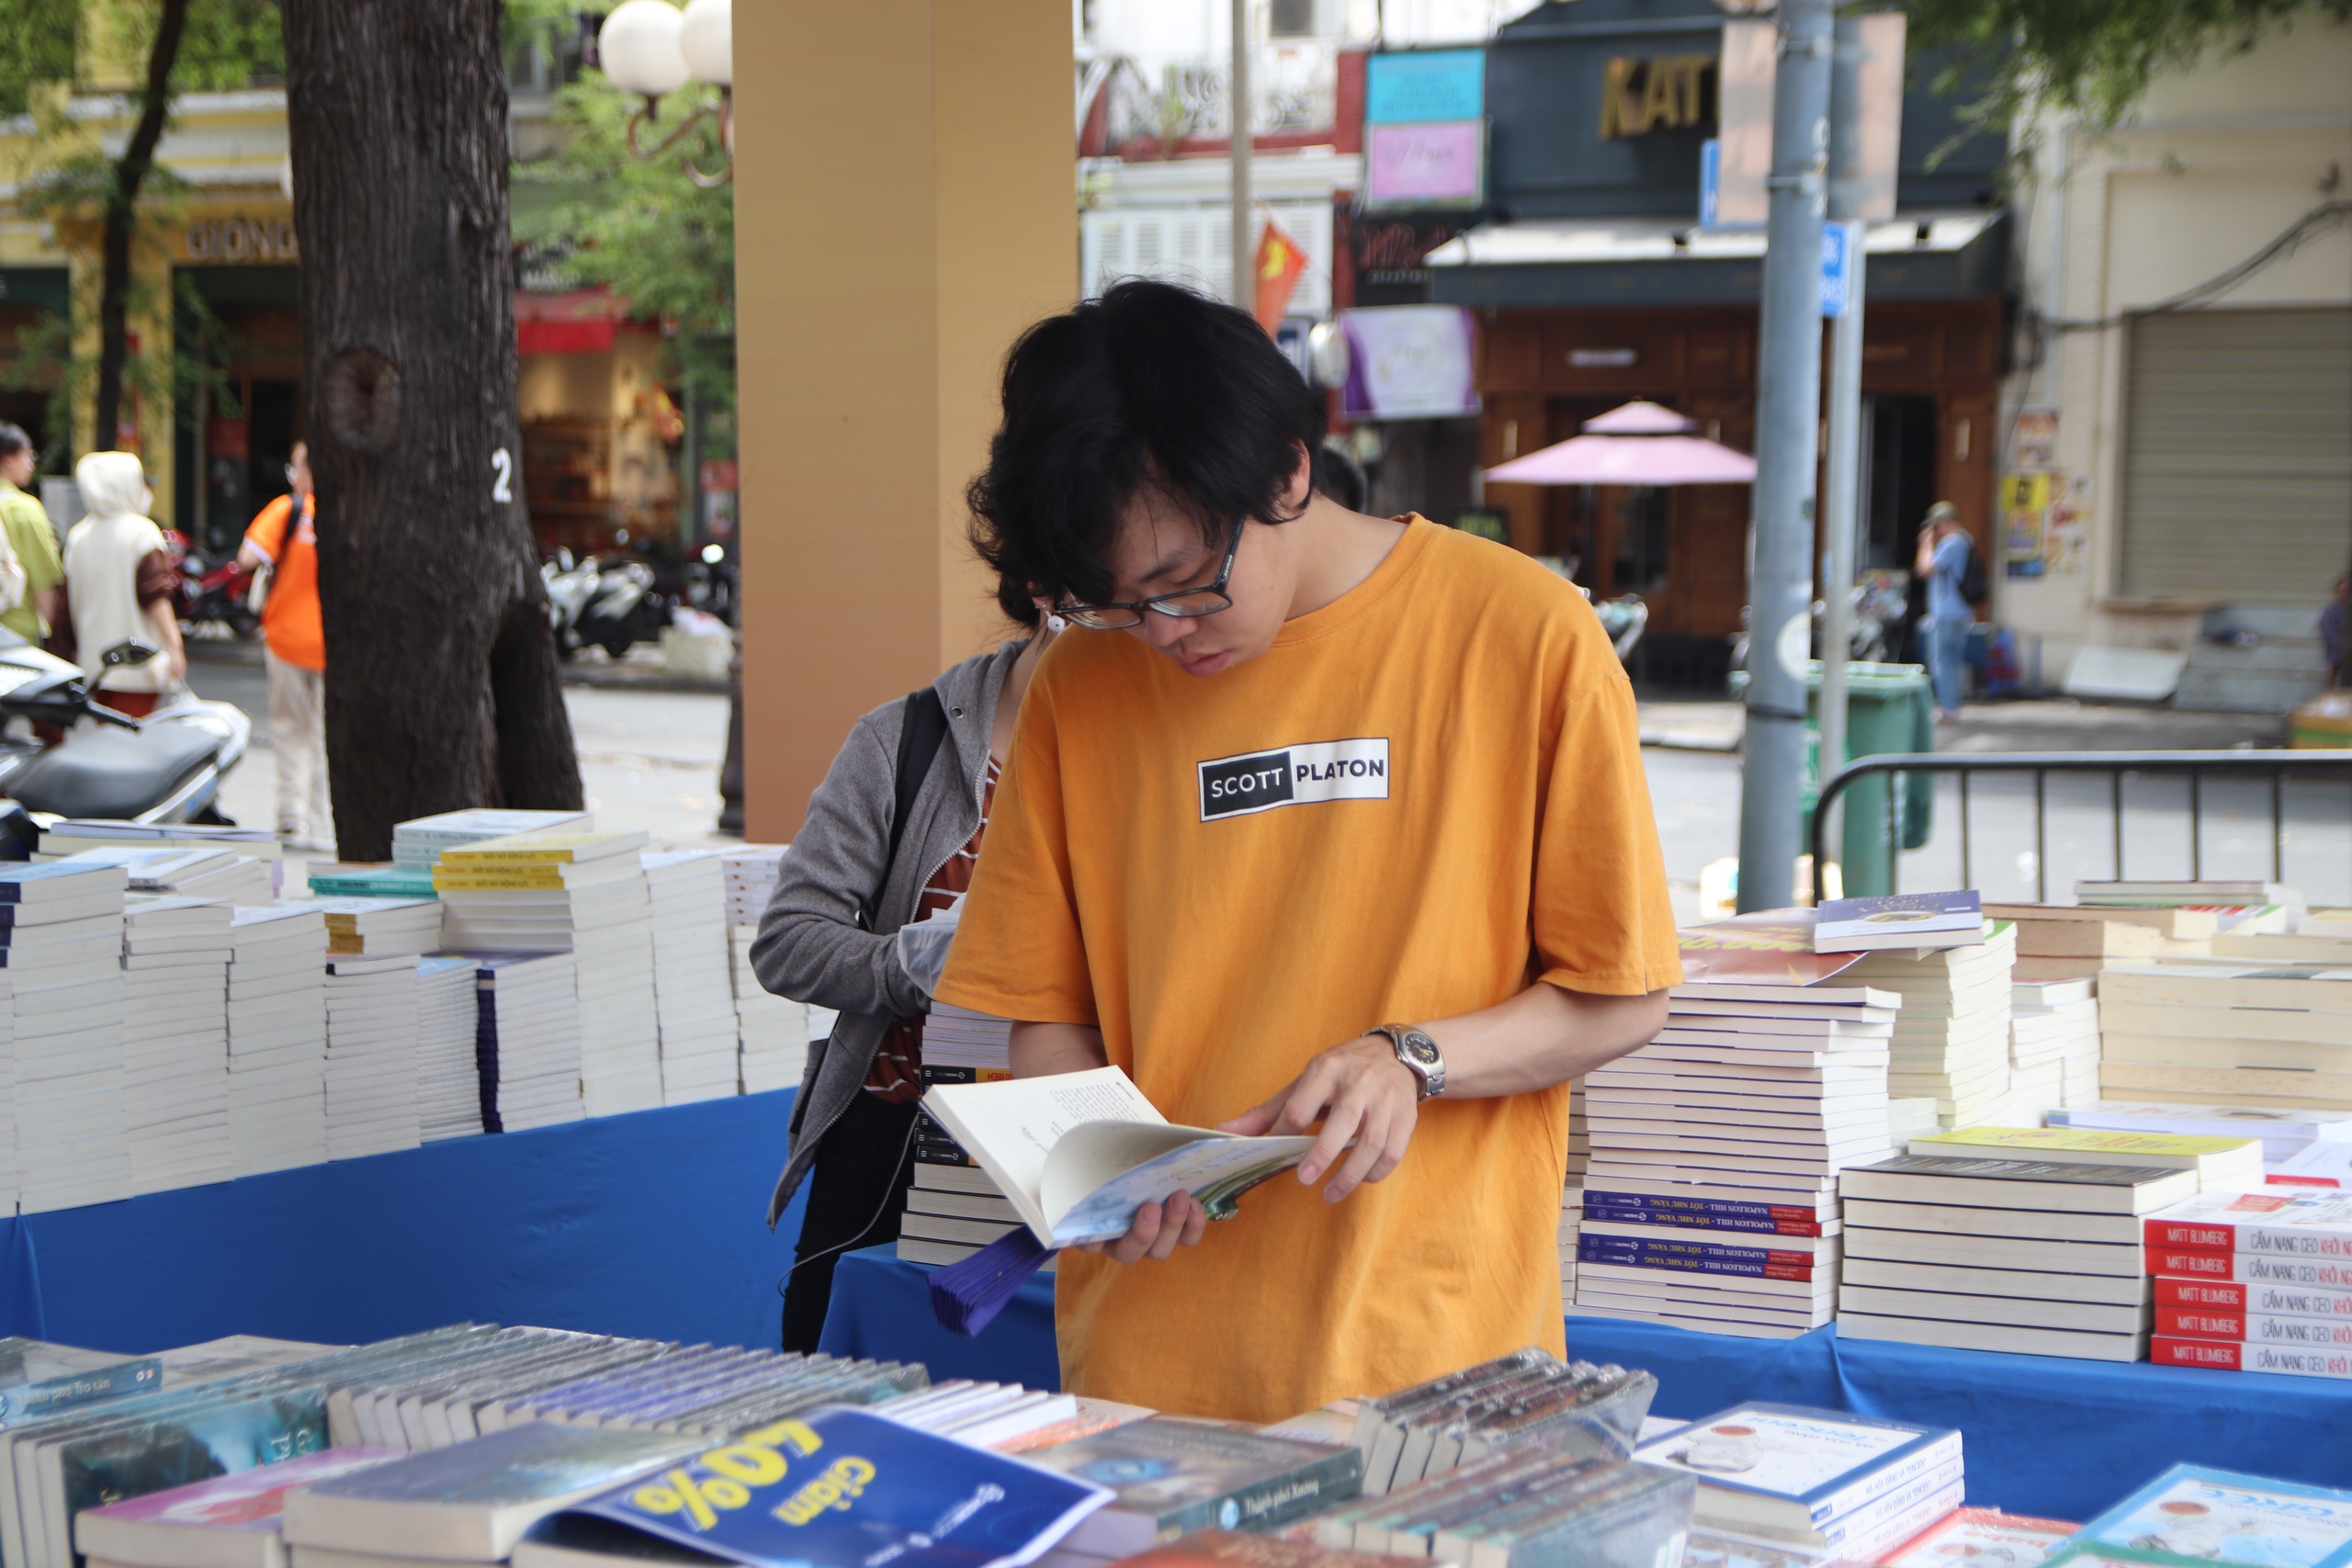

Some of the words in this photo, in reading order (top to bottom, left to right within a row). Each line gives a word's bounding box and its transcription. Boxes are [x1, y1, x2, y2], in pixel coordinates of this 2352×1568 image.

[1599, 52, 1723, 140] KAT
[492, 446, 513, 503] 2
[1211, 767, 1284, 798] SCOTT
[1295, 759, 1385, 783] PLATON
[1650, 1199, 1670, 1207] VÀNG
[1671, 1200, 1689, 1208] NHƯ
[1690, 1201, 1704, 1211] TỐT
[1727, 1204, 1768, 1214] NAPOLEON
[1656, 1213, 1676, 1222] VÀNG
[1677, 1214, 1694, 1223] NHƯ
[1696, 1216, 1711, 1225] TỐT
[1735, 1219, 1775, 1229] NAPOLEON
[2168, 1228, 2188, 1242] MATT
[2190, 1229, 2227, 1246] BLUMBERG
[1647, 1243, 1668, 1251] VÀNG
[1668, 1244, 1686, 1253] NHƯ
[2273, 1236, 2297, 1252] NANG
[2300, 1237, 2319, 1253] CEO
[1688, 1246, 1702, 1255] TỐT
[1725, 1249, 1766, 1258] NAPOLEON
[1645, 1257, 1665, 1265] VÀNG
[1665, 1258, 1682, 1266] NHƯ
[1684, 1258, 1699, 1269] TỐT
[1703, 1261, 1721, 1269] HILL
[2166, 1255, 2187, 1269] MATT
[2188, 1257, 2227, 1273] BLUMBERG
[1722, 1262, 1762, 1273] NAPOLEON
[2271, 1264, 2296, 1280] NANG
[2298, 1266, 2316, 1282] CEO
[2178, 1286, 2199, 1301] MATT
[2201, 1288, 2239, 1304] BLUMBERG
[2286, 1295, 2310, 1312] NANG
[2312, 1297, 2332, 1314] CEO
[2177, 1315, 2199, 1330] MATT
[2200, 1316, 2238, 1334] BLUMBERG
[2284, 1325, 2310, 1341] NANG
[2312, 1325, 2331, 1343] CEO
[2174, 1345, 2195, 1359] MATT
[2196, 1347, 2234, 1363] BLUMBERG
[2280, 1354, 2304, 1371] NANG
[2308, 1356, 2326, 1372] CEO
[1906, 1458, 1928, 1475] TENCENT
[773, 1455, 876, 1527] Giảm
[1913, 1481, 1931, 1497] TENCENT
